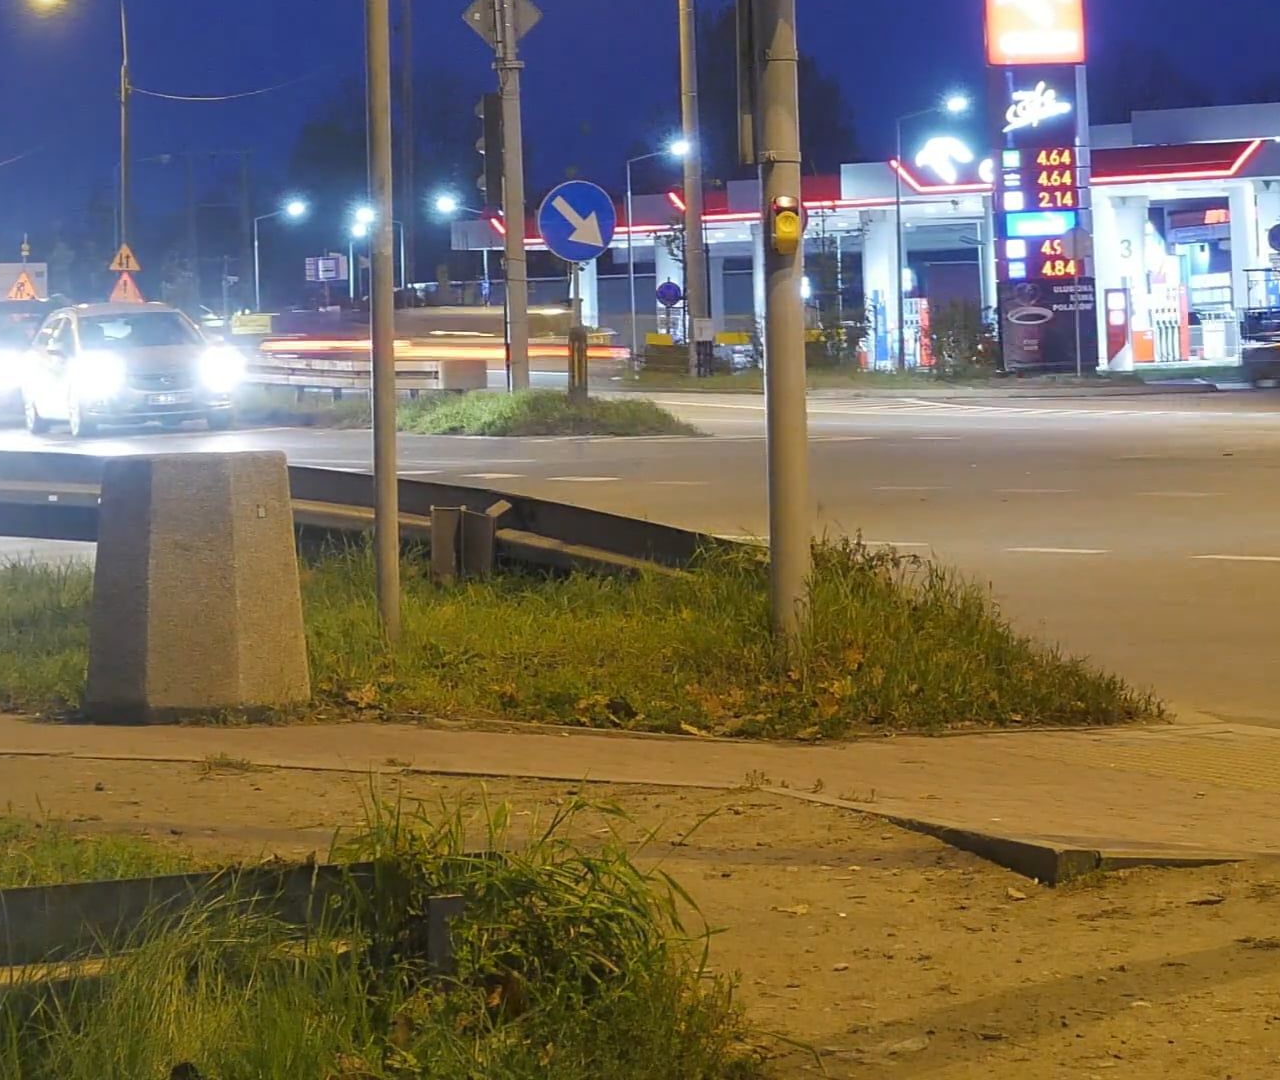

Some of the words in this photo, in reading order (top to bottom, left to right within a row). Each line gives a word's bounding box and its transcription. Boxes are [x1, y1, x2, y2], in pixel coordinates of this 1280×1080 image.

[1036, 149, 1072, 166] 4.64
[1037, 170, 1072, 187] 4.64
[1038, 191, 1074, 208] 2.14
[1040, 239, 1062, 256] 4.9
[1120, 239, 1133, 259] 3
[1041, 259, 1077, 277] 4.84
